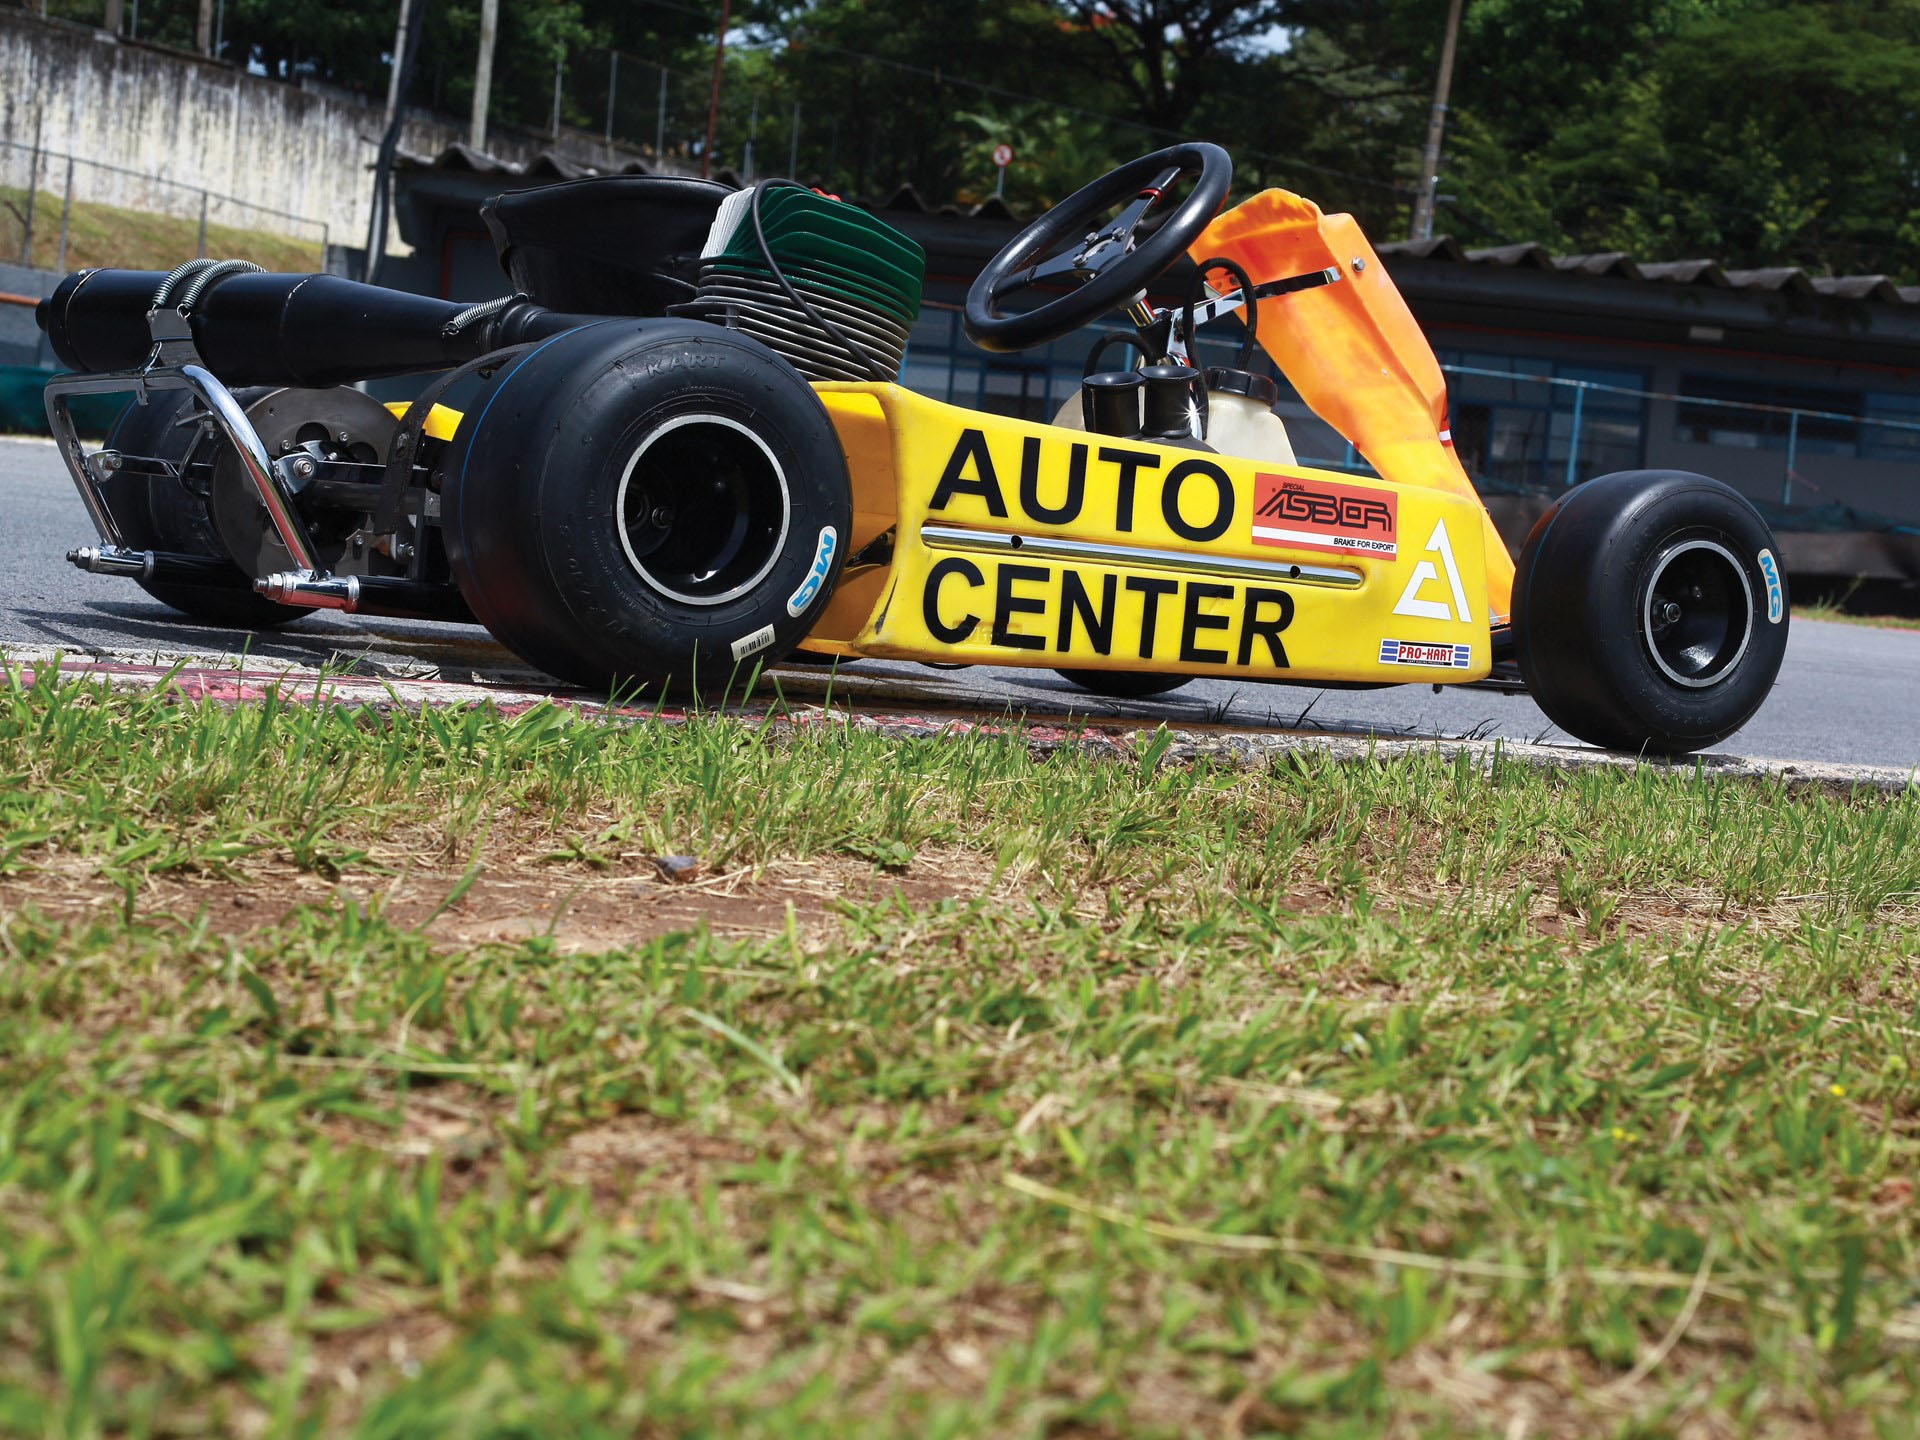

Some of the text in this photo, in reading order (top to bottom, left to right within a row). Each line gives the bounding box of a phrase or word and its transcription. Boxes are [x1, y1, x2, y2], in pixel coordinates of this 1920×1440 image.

[646, 354, 726, 378] KART
[929, 428, 1235, 542] AUTO
[1282, 482, 1305, 491] SPECIAL
[1333, 537, 1394, 551] BRAKE FOR EXPORT
[791, 532, 834, 609] MG
[1760, 556, 1780, 617] MG
[922, 557, 1295, 669] CENTER
[1398, 646, 1454, 662] PRO-KART
